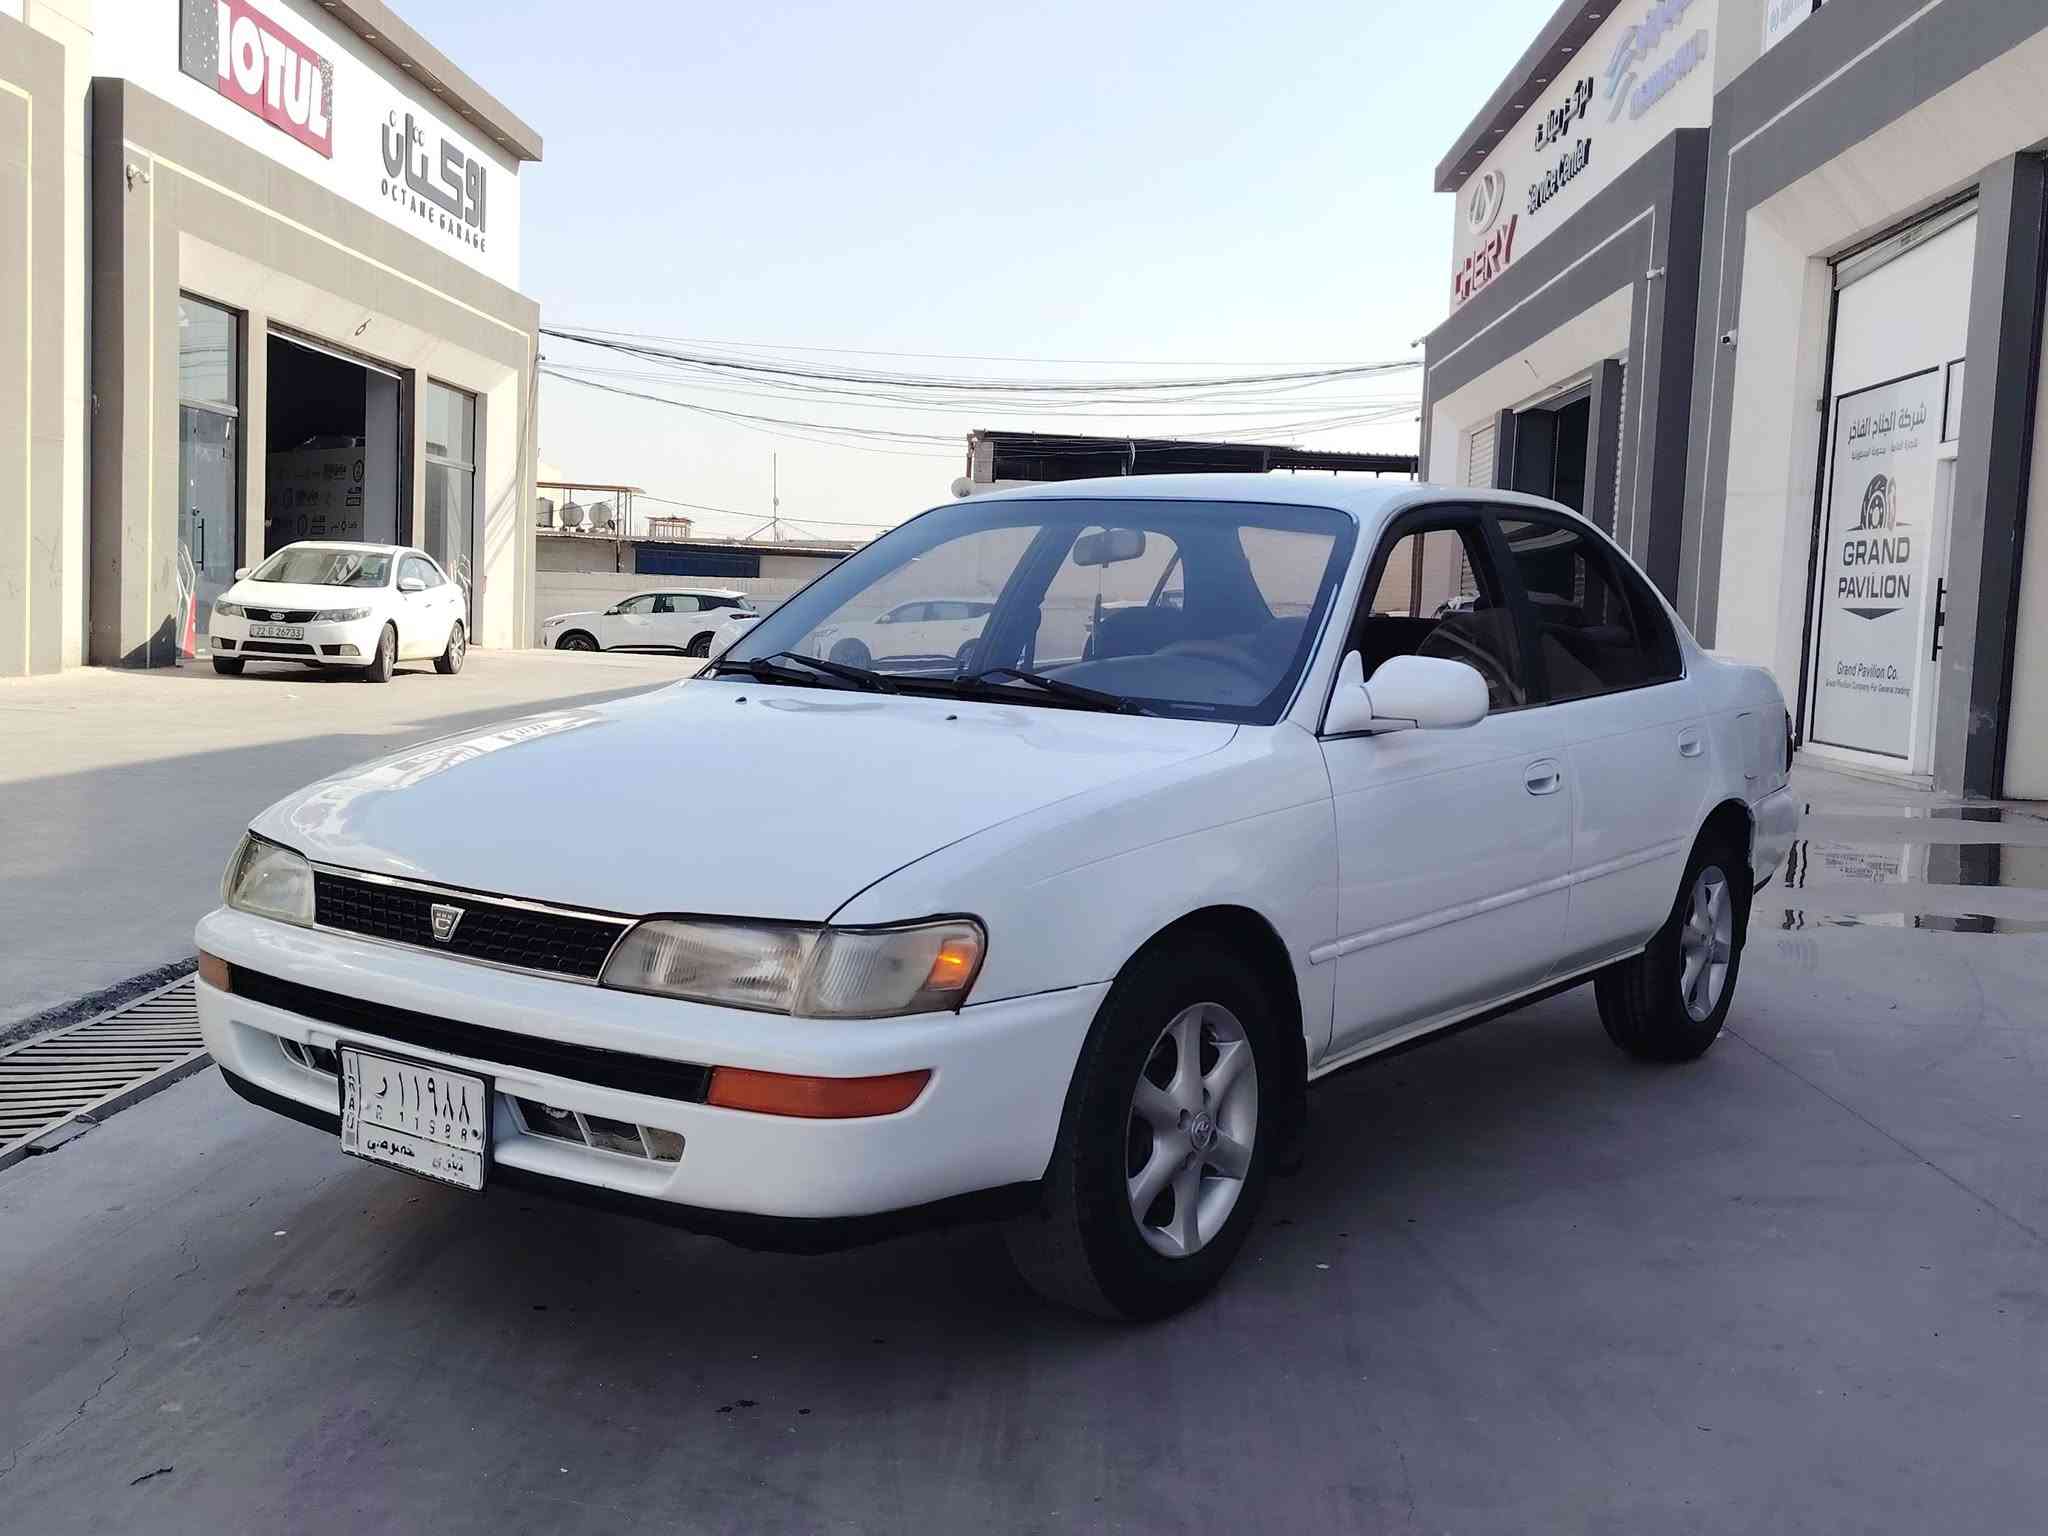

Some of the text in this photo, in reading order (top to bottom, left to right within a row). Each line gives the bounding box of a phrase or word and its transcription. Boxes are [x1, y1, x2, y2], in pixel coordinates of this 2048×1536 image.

[1527, 137, 1592, 216] Service Center
[381, 178, 487, 253] OCTANE GARAGE
[1847, 400, 1928, 446] شركة الجناح الفاخر
[1843, 536, 1911, 566] GRAND
[1838, 574, 1911, 599] PAVILION
[1837, 660, 1857, 677] Grand
[1857, 662, 1885, 679] Pavilion
